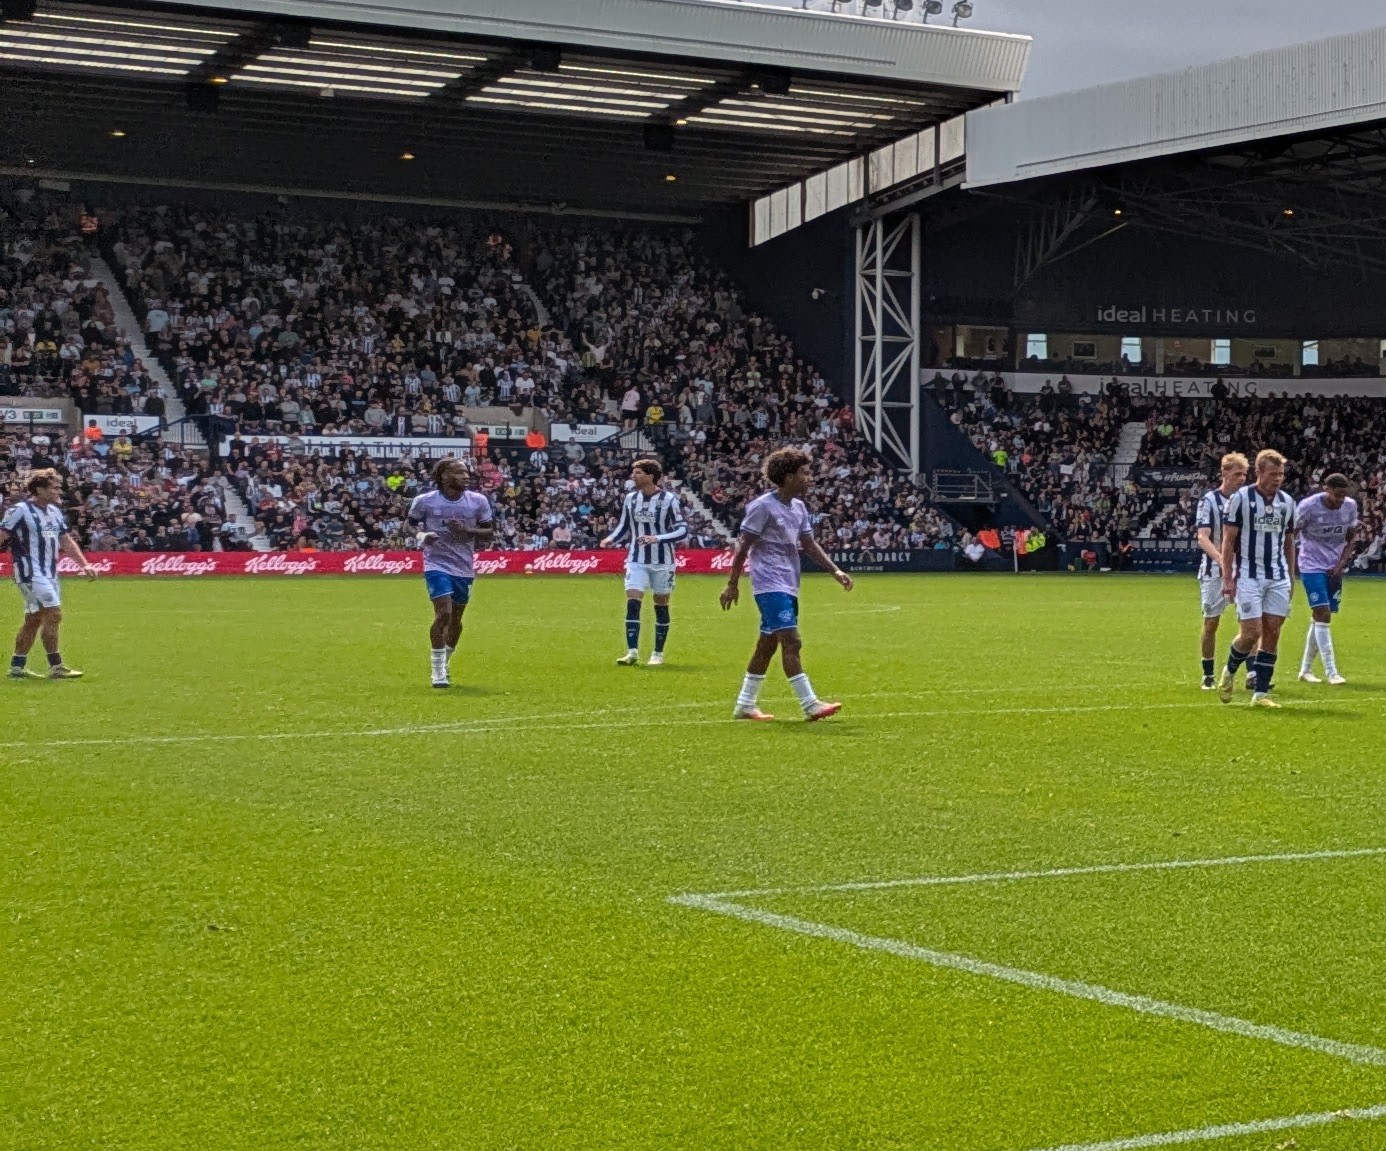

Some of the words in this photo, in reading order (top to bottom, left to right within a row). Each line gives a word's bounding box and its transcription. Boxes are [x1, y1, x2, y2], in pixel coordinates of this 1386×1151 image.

[1097, 305, 1146, 323] ideal
[1153, 308, 1256, 324] HEATING
[1100, 378, 1147, 396] ieal
[1155, 381, 1257, 396] HEATNG
[1255, 515, 1284, 525] idea
[141, 554, 220, 575] Kellogg's
[245, 554, 320, 575] Kellogg's
[344, 553, 418, 574] Kellogg's
[534, 552, 603, 574] Kellogg's
